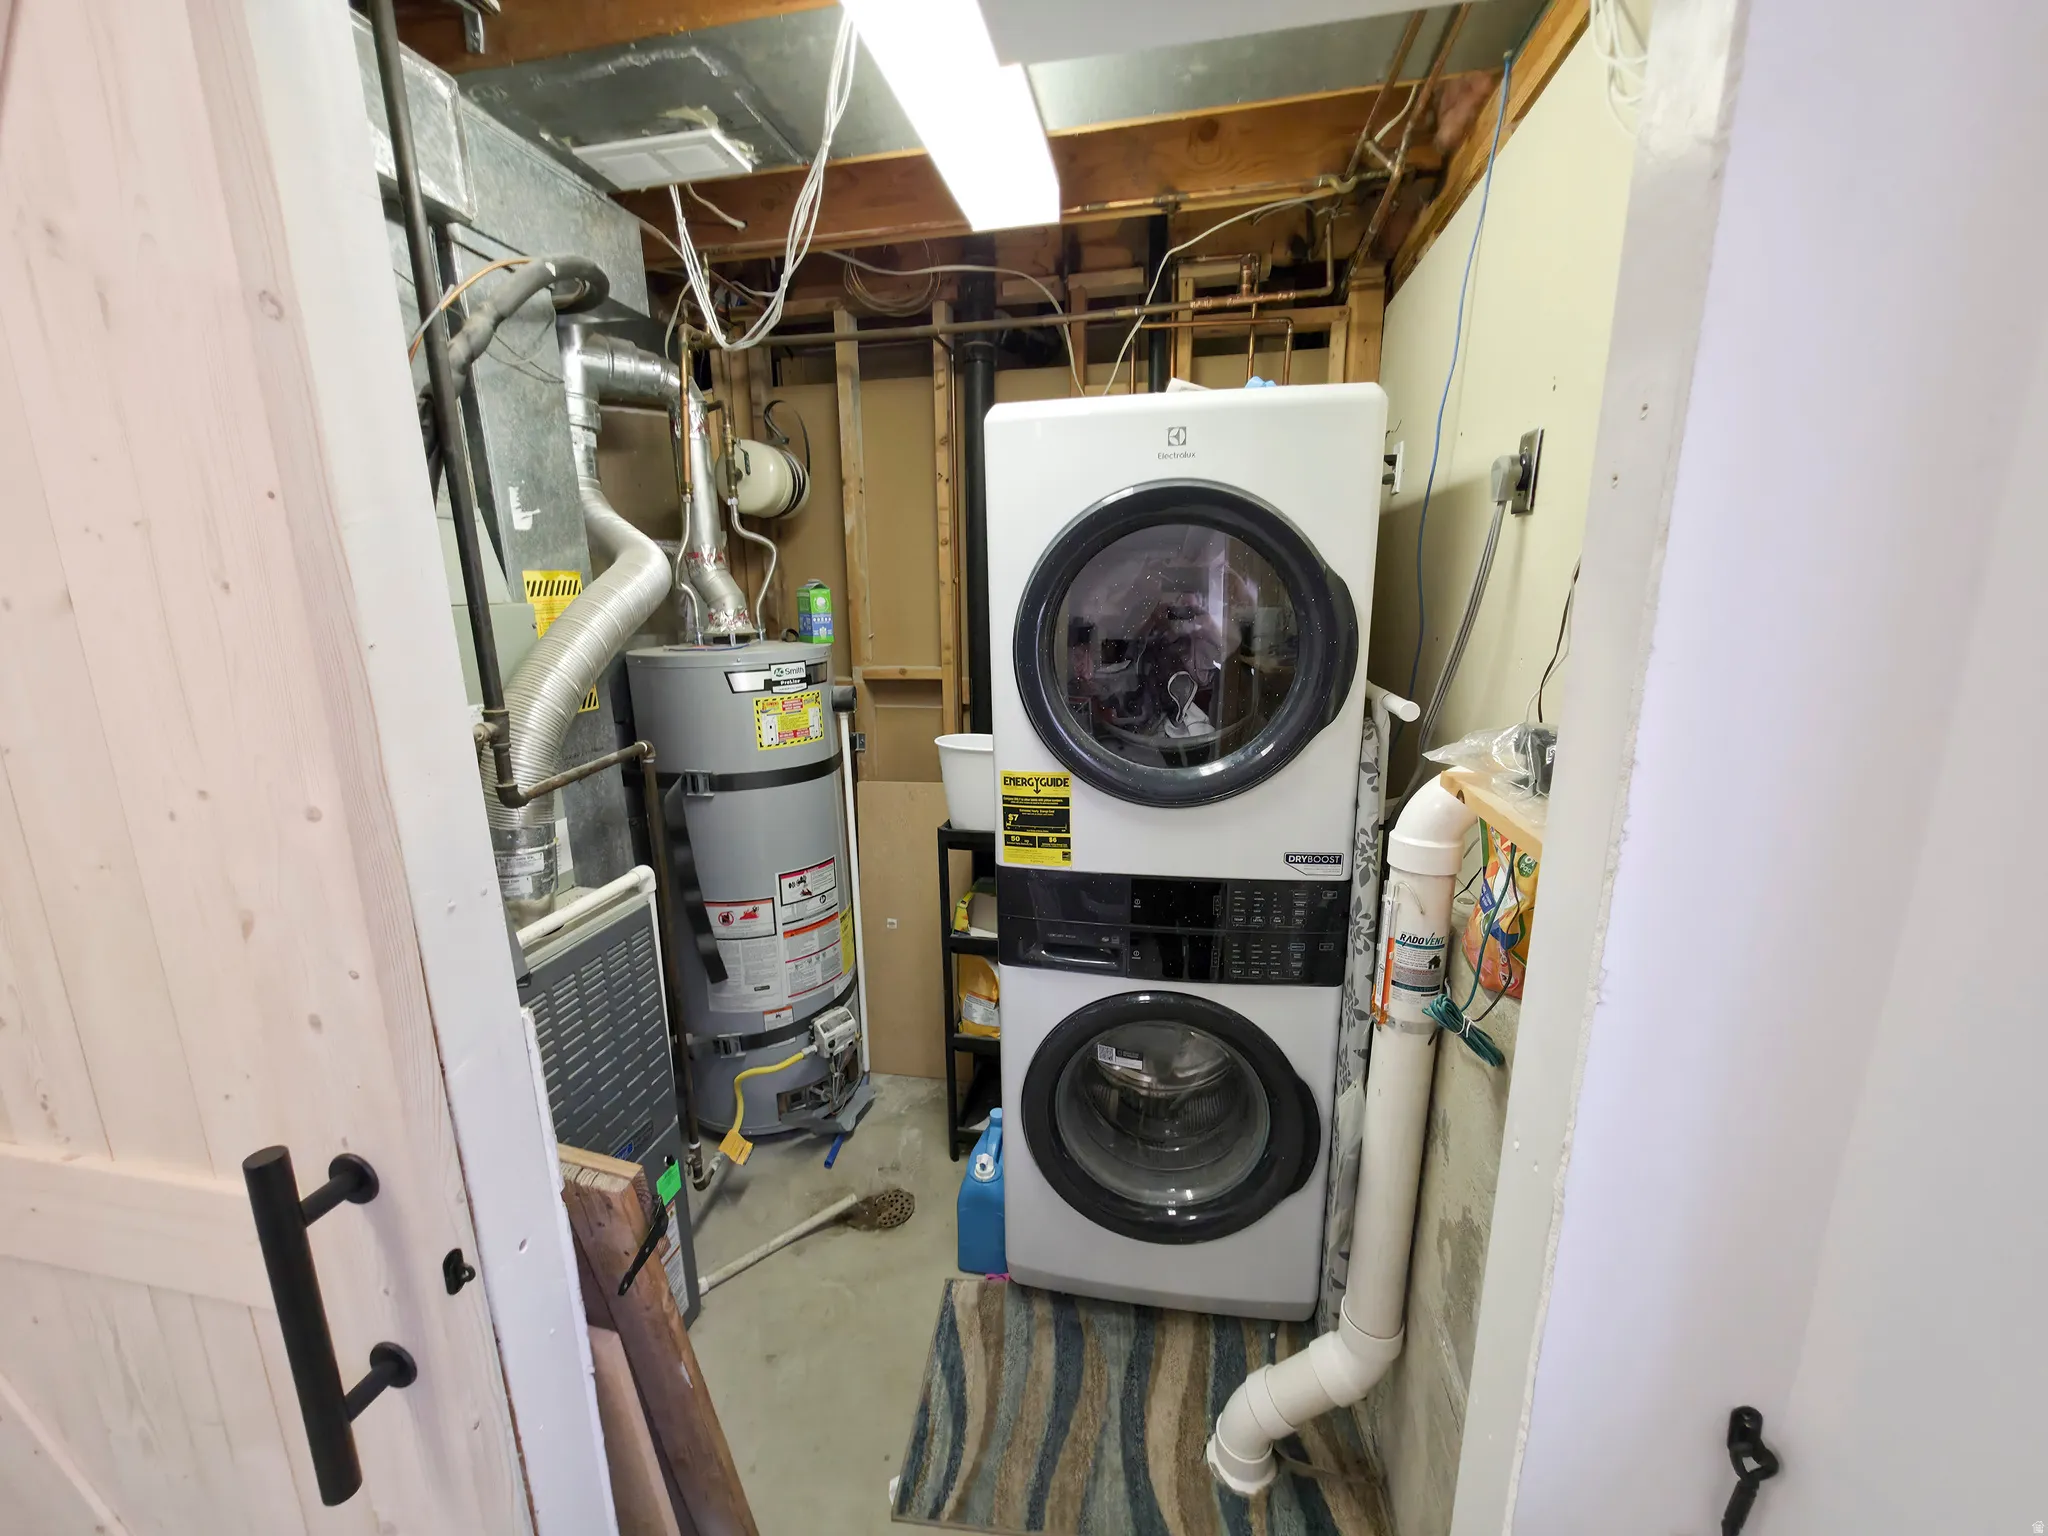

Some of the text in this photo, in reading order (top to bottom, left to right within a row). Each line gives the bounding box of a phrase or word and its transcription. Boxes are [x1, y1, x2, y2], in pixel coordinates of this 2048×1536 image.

[1157, 451, 1196, 460] Electrolux
[784, 666, 804, 676] Smith
[1003, 776, 1069, 789] ENERGYGUIDE
[1007, 813, 1019, 822] $7
[1288, 855, 1340, 864] DRYBOOST
[1399, 932, 1446, 947] RADOVENT
